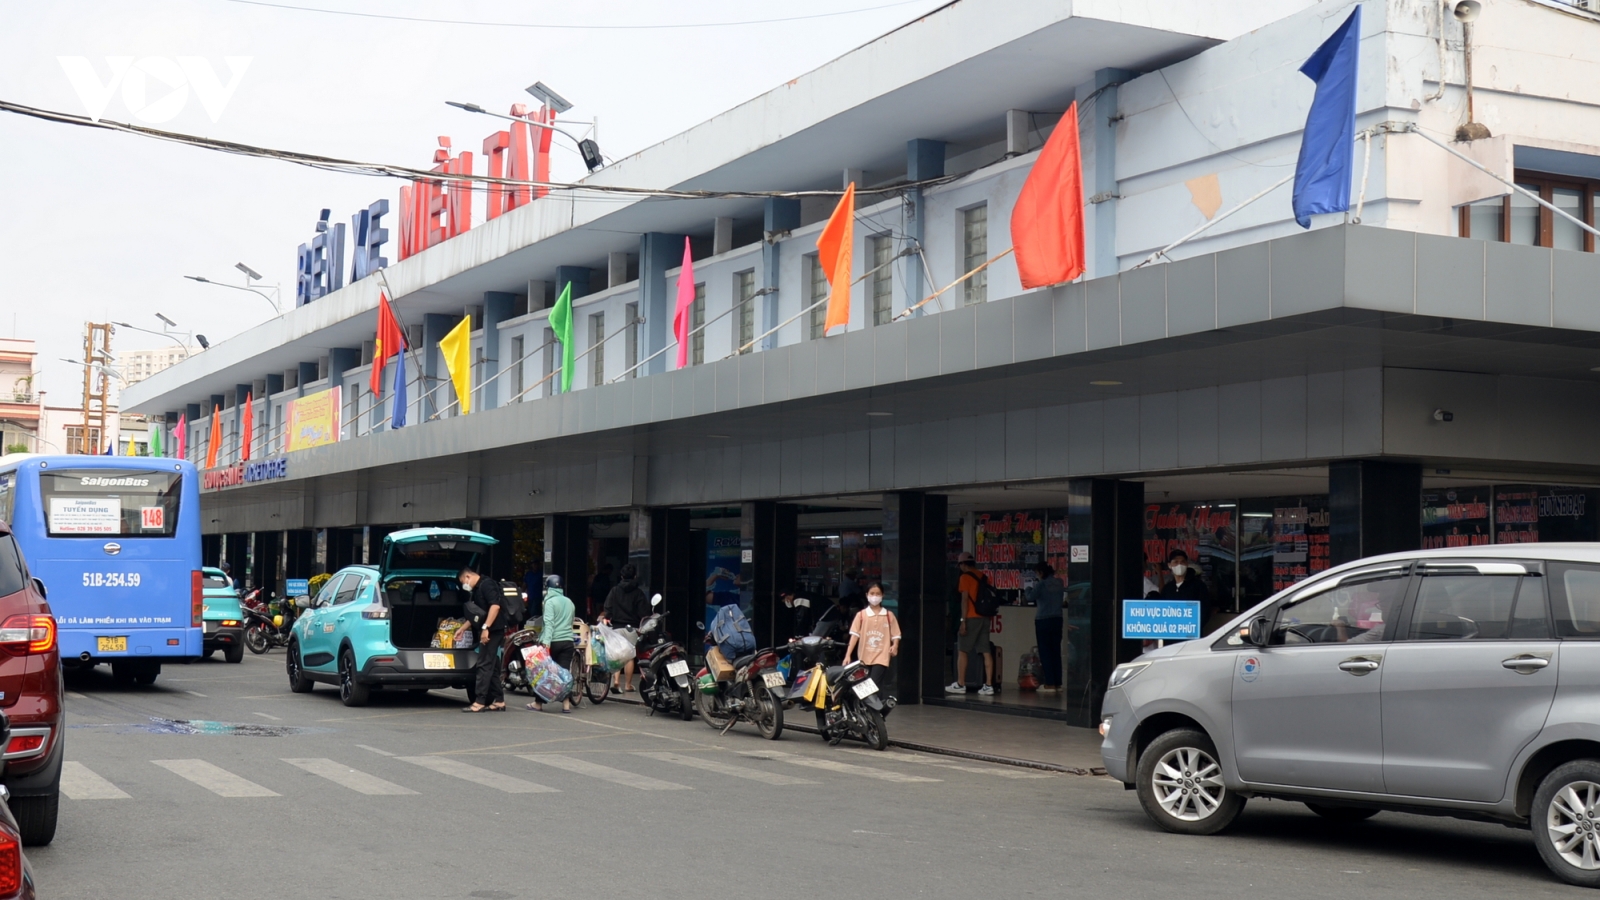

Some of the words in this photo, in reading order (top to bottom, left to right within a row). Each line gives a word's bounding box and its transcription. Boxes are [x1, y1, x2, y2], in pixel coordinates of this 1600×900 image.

[296, 208, 346, 308] BẾN
[350, 199, 389, 285] XE
[398, 136, 473, 263] MIỀN
[482, 103, 556, 222] TÂY
[81, 476, 149, 487] SaigonBus
[143, 509, 162, 526] 148
[82, 572, 141, 587] 51B-254.59
[1130, 607, 1145, 617] KHU
[1146, 606, 1161, 619] VỰC
[1162, 606, 1182, 618] DỪNG
[1183, 608, 1193, 618] XE
[1126, 621, 1151, 633] KHÔNG
[1152, 621, 1168, 633] QUÁ
[1168, 624, 1177, 633] 02
[1178, 622, 1196, 634] PHÚT
